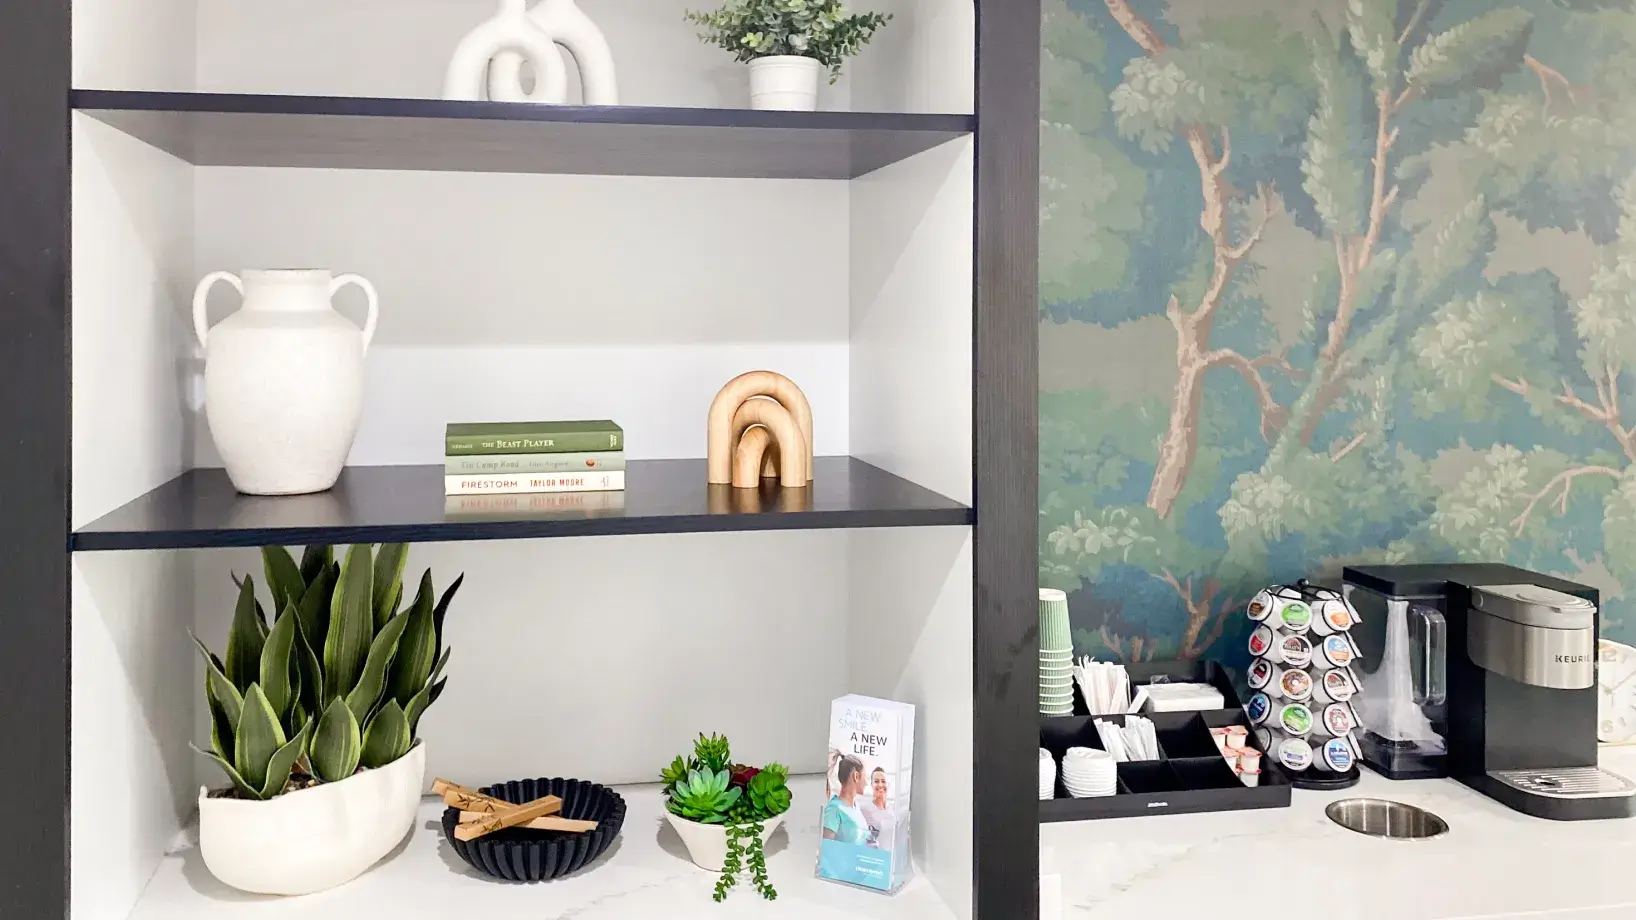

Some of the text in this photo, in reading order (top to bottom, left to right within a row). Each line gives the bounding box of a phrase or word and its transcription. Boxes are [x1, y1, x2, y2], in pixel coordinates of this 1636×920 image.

[496, 439, 521, 448] BEAST
[524, 438, 554, 448] PLAYER
[476, 460, 498, 470] Camp
[461, 480, 518, 489] FIRESTORM
[530, 478, 584, 487] TAYLOR MOORE
[845, 708, 882, 723] A NEW
[838, 718, 867, 732] SMILE
[850, 731, 888, 746] A NEW
[853, 743, 879, 757] LIFE.
